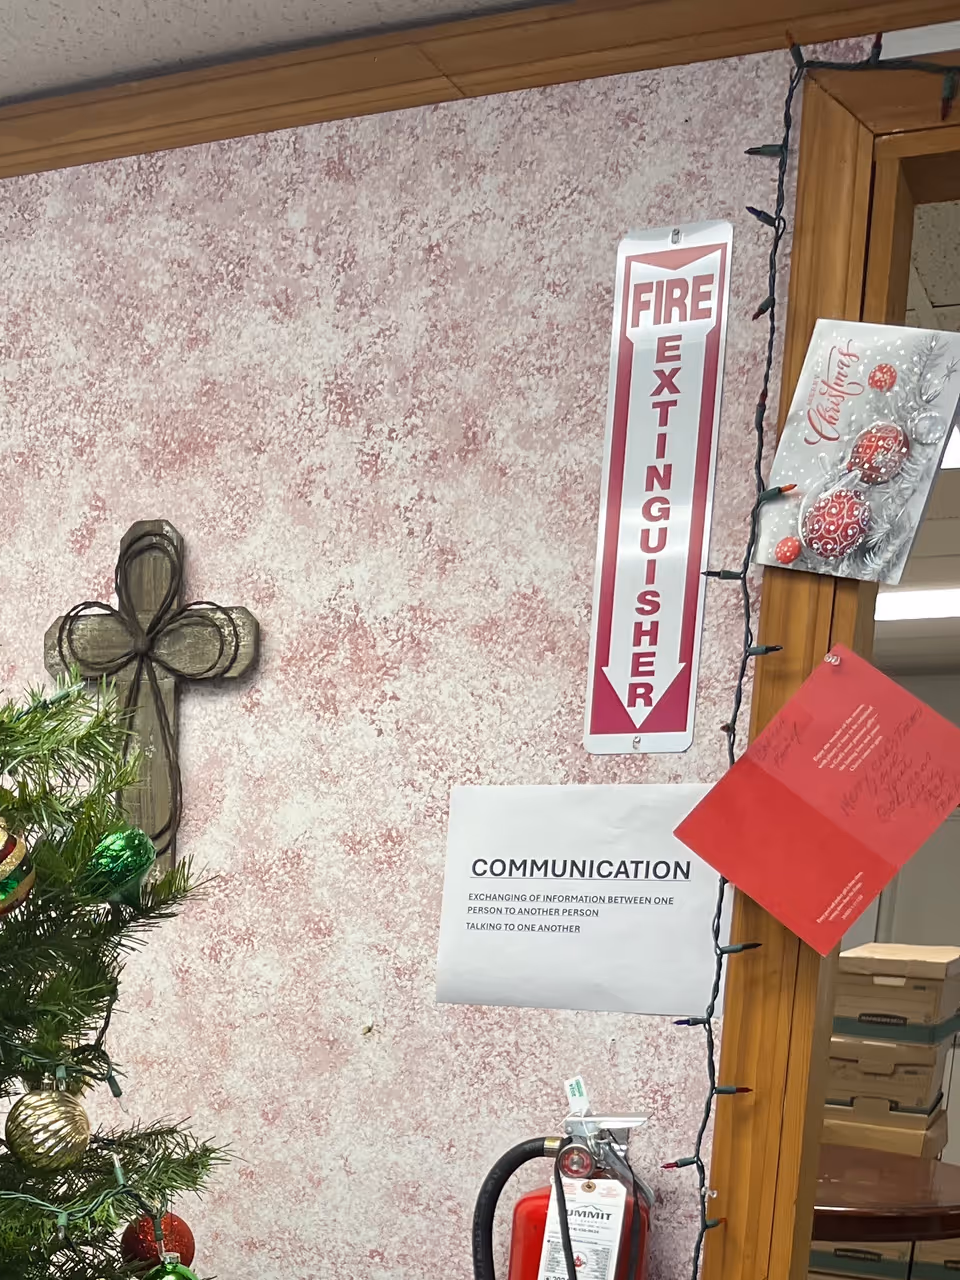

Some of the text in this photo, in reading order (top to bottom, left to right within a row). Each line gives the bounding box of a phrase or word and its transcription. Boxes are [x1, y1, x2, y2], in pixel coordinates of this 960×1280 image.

[631, 273, 715, 329] FIRE
[803, 338, 860, 446] Christmas
[626, 334, 681, 708] EXTINGUISHER
[471, 858, 691, 880] COMMUNICATION
[468, 893, 527, 902] EXCHANGING
[543, 895, 606, 903] INFORMATION
[608, 896, 651, 904] BETWEEN
[517, 908, 560, 916] ANOTHER
[562, 908, 599, 917] PERSON
[466, 922, 502, 931] TALKING
[517, 923, 536, 931] ONE
[538, 924, 580, 933] ANOTHER
[566, 1209, 612, 1220] UMMIT
